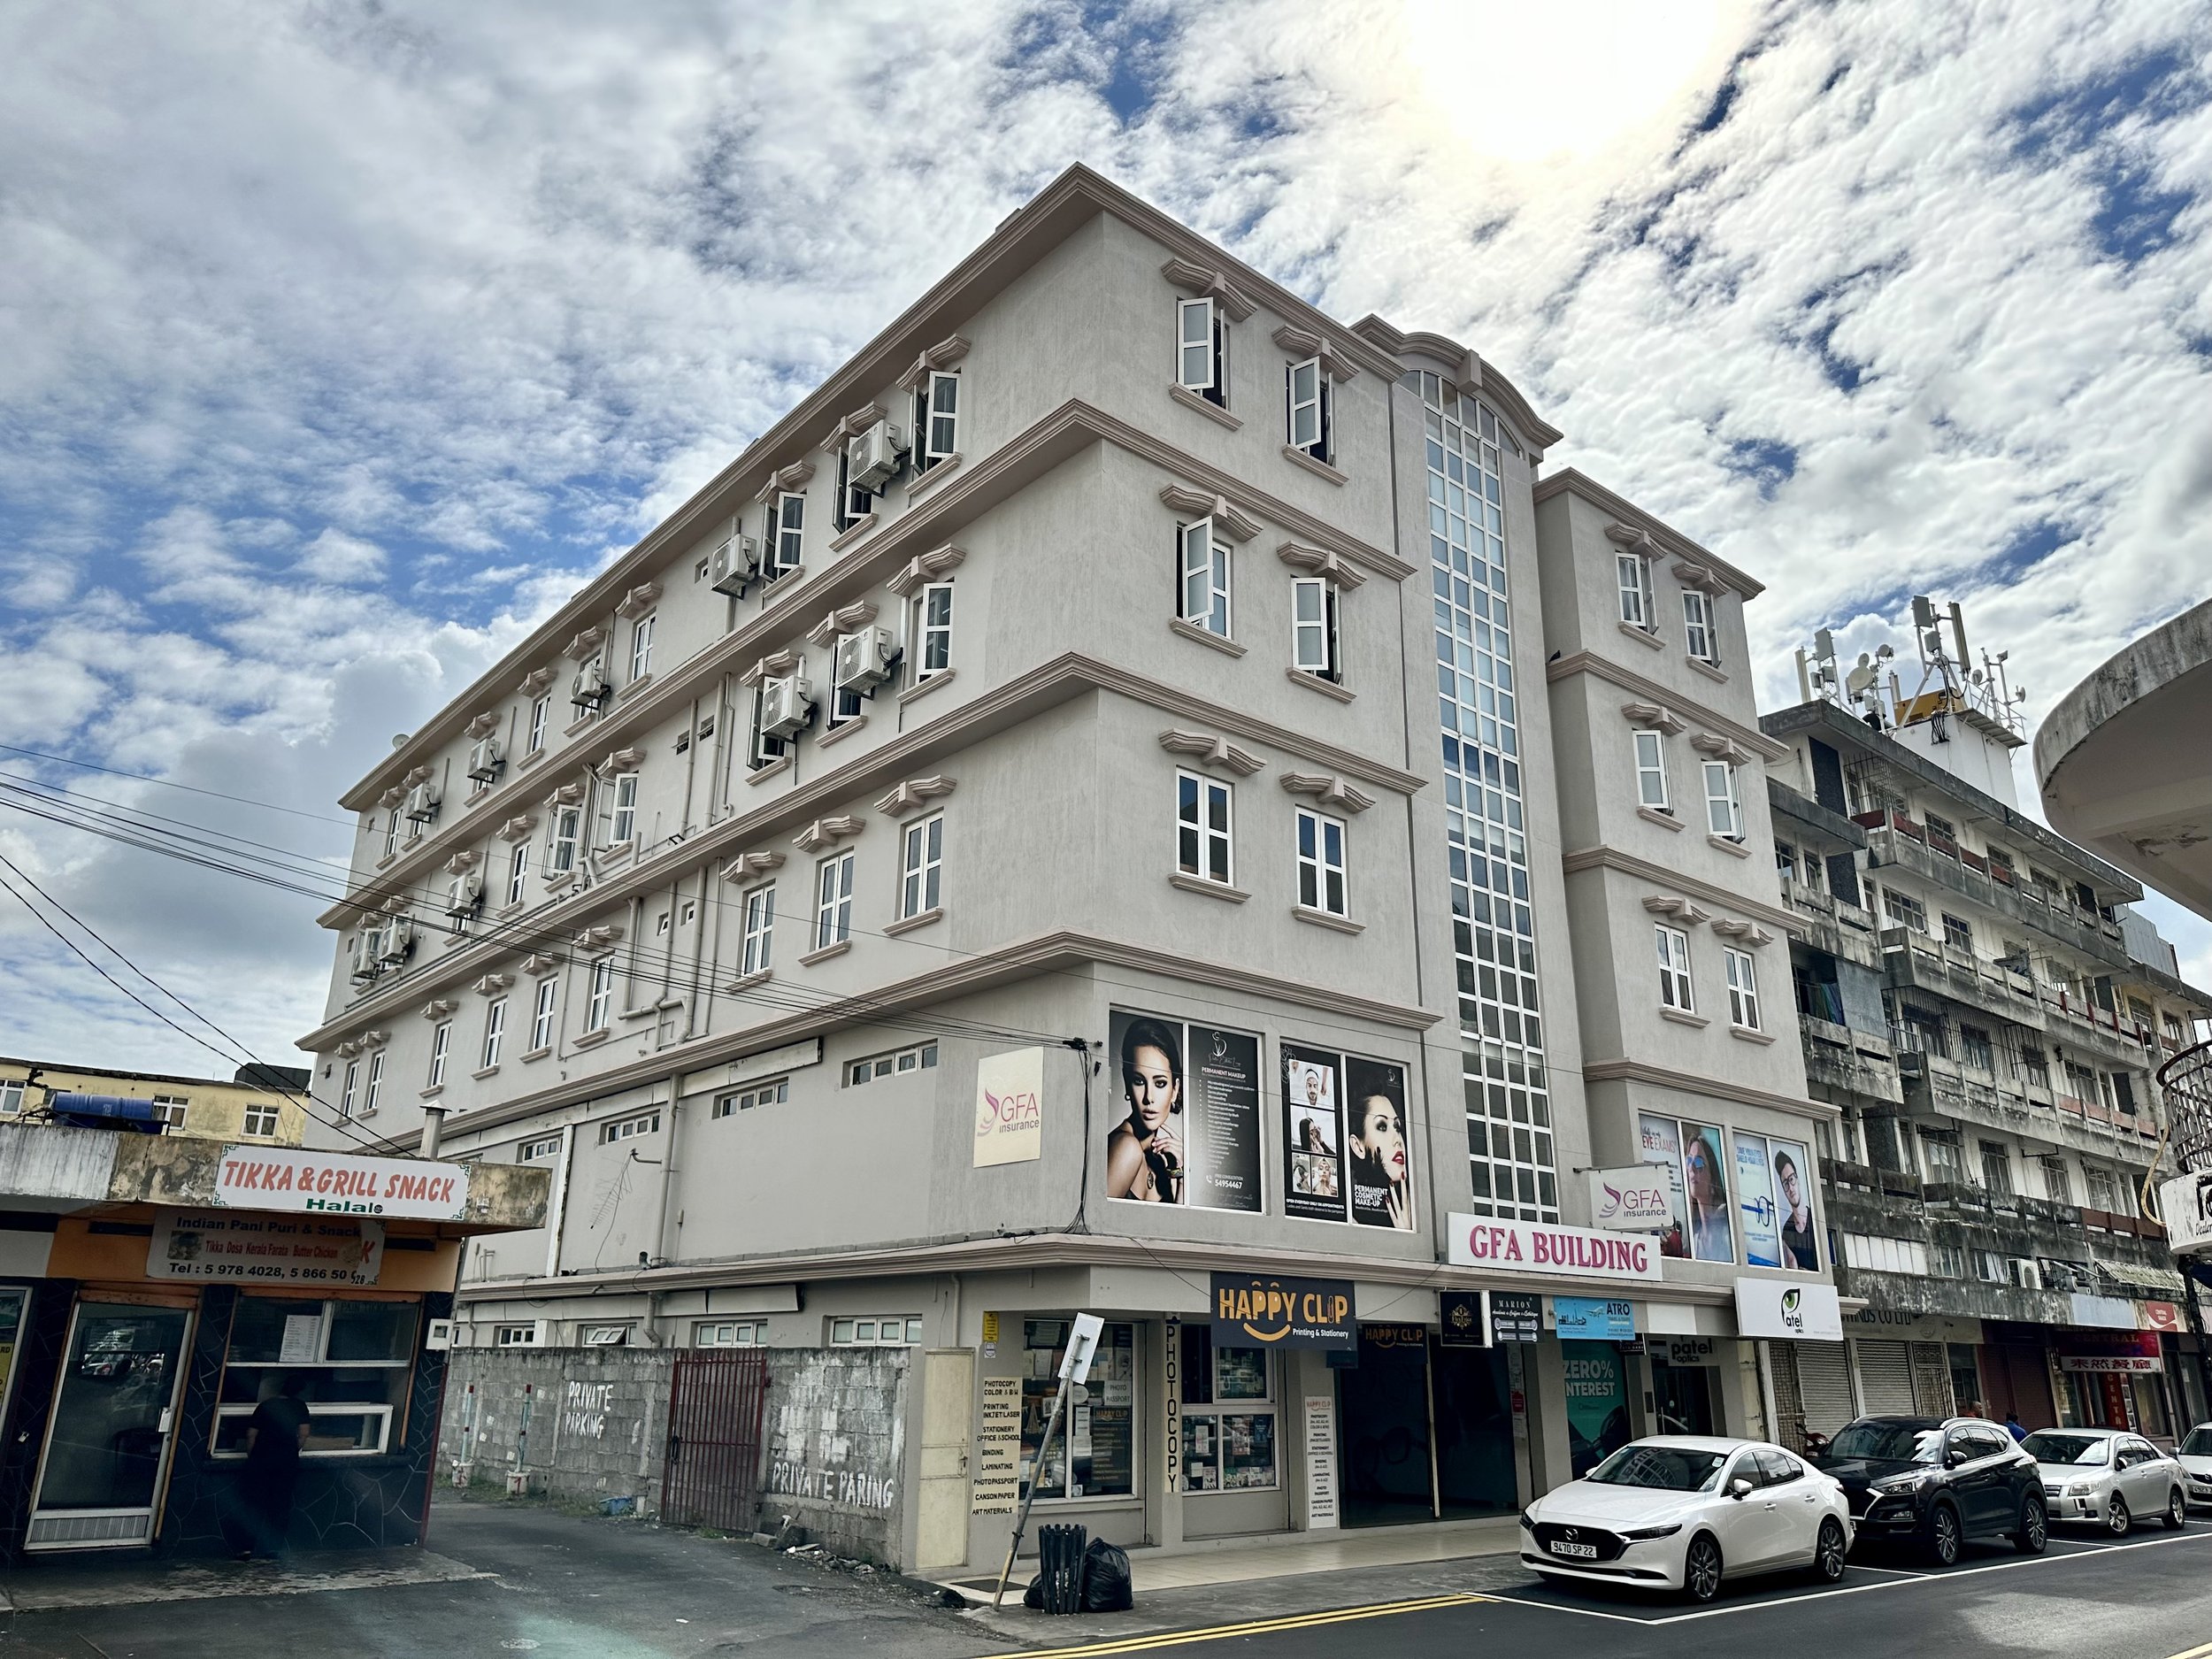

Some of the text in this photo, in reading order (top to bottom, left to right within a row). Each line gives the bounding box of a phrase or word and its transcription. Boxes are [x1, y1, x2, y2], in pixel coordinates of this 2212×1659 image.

[1202, 1066, 1227, 1076] PERMANENT
[1001, 1093, 1039, 1122] GFA
[1000, 1119, 1040, 1133] insurance
[1642, 1136, 1654, 1149] EYE
[224, 1161, 293, 1191] TIKKA
[384, 1174, 455, 1203] SNACK
[1215, 1179, 1242, 1189] 54954467
[1355, 1184, 1387, 1195] PERMANENT
[1355, 1191, 1382, 1202] COSMETIC
[1624, 1189, 1664, 1210] GFA
[306, 1198, 372, 1214] Halal
[177, 1217, 361, 1237] Indian Pani Puri & Snack
[205, 1240, 337, 1259] Tikka Dosa Kerala Farata Butter Chicken
[1470, 1225, 1647, 1272] GFA BUILDING
[218, 1264, 243, 1276] 978
[248, 1266, 285, 1279] 4028,
[302, 1268, 326, 1279] 866
[1219, 1288, 1348, 1324] HAPPY CLIP
[1499, 1300, 1531, 1309] MARION
[1607, 1302, 1630, 1316] ATRO
[1293, 1328, 1315, 1339] Printing
[1320, 1329, 1349, 1340] Stationery
[1365, 1328, 1398, 1340] HAPPY
[2074, 1333, 2139, 1342] CENTRAL
[1671, 1338, 1713, 1359] patel
[1677, 1355, 1700, 1363] optics
[1563, 1359, 1614, 1379] ZERO%
[568, 1380, 613, 1412] PRIVATE
[1565, 1382, 1615, 1396] NTEREST
[1165, 1325, 1177, 1493] PHOTOCOPY
[565, 1411, 604, 1440] PARKING
[772, 1462, 833, 1501] PRIVATE
[1554, 1542, 1594, 1556] 9470 SP 22
